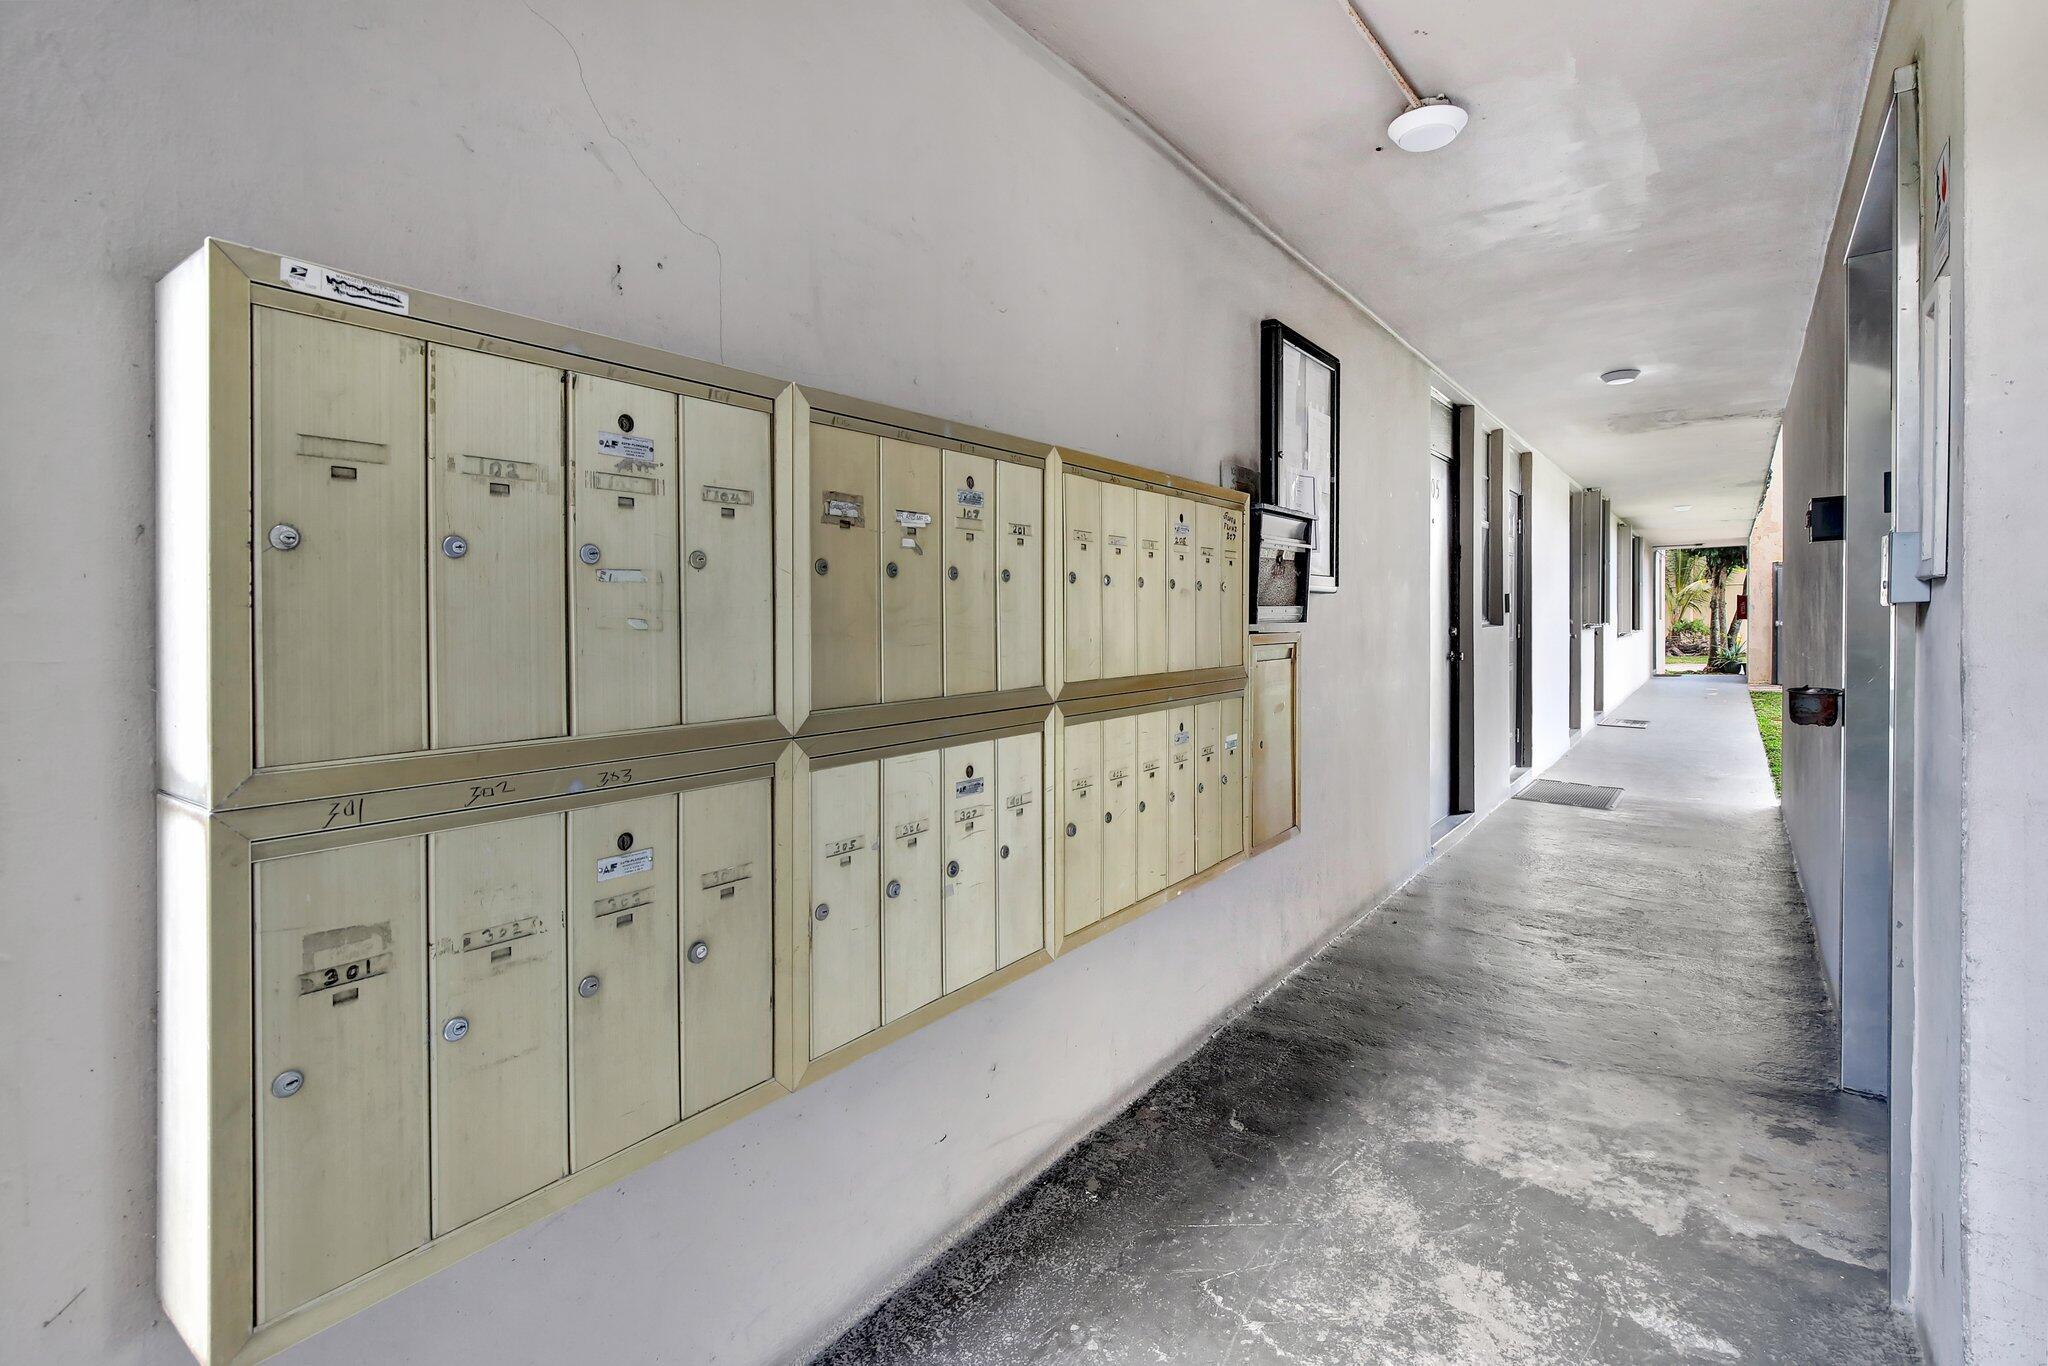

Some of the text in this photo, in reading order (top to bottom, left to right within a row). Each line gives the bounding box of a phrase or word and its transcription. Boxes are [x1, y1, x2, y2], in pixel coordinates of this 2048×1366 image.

[1012, 524, 1026, 535] 201
[464, 781, 516, 808] 302
[322, 798, 364, 829] 301
[323, 959, 371, 986] 301
